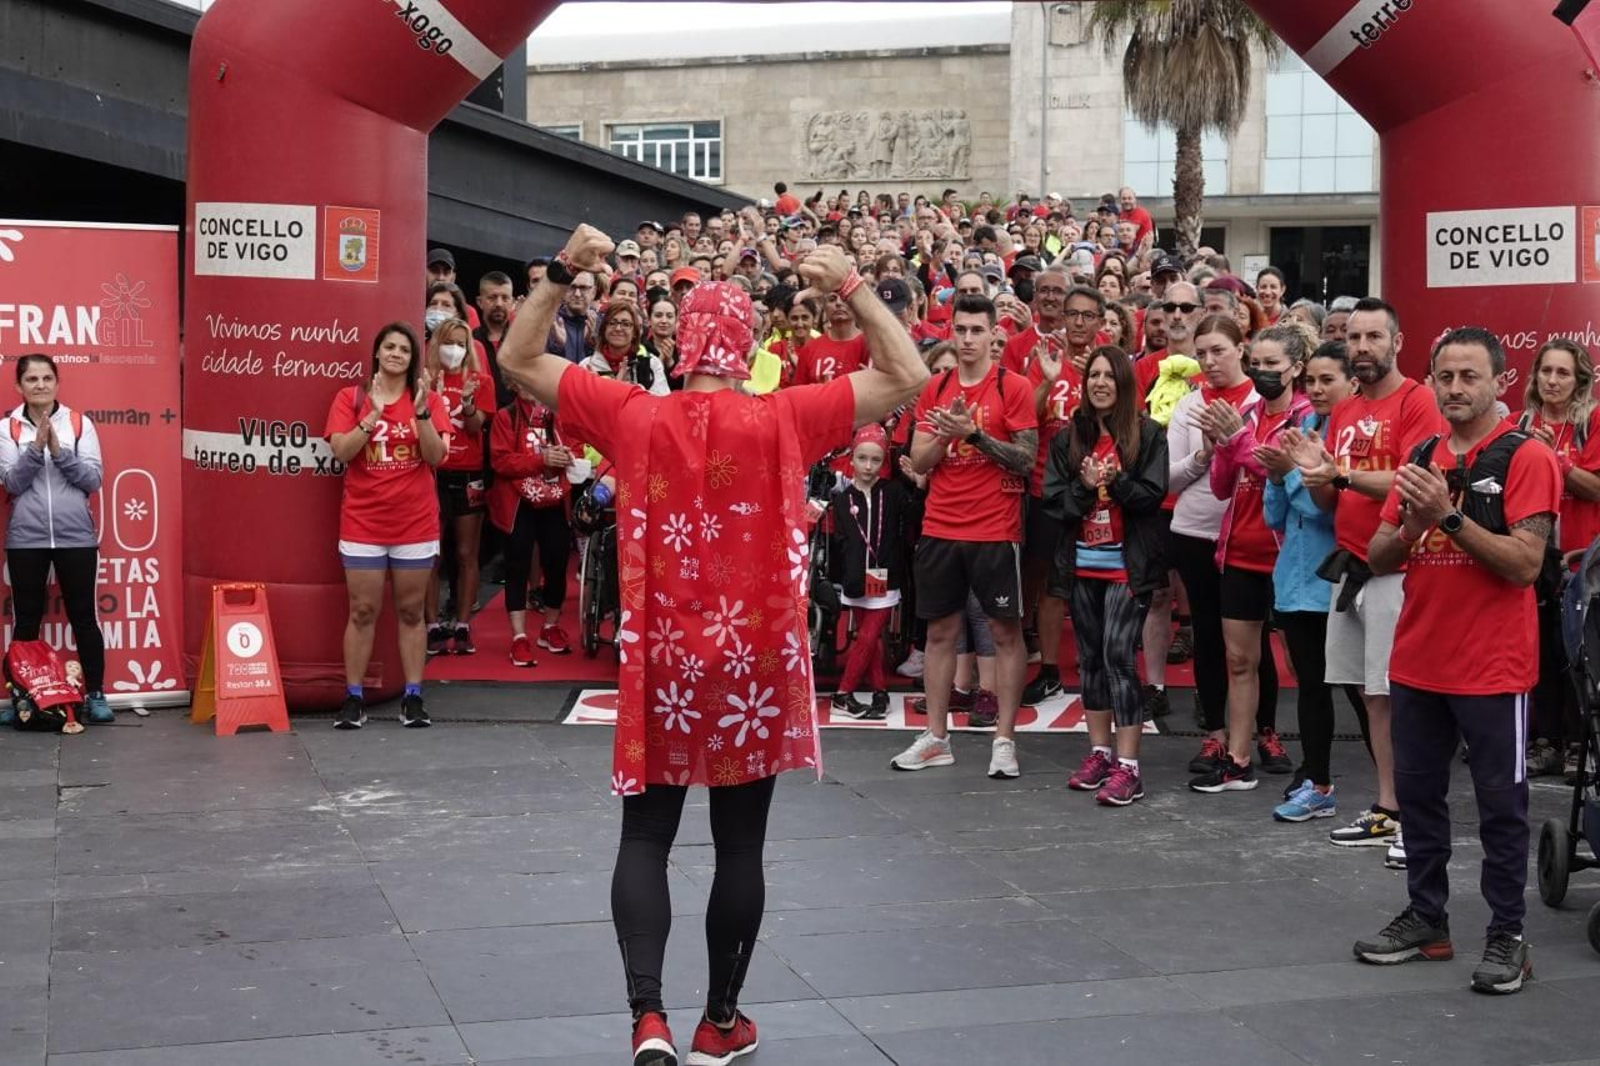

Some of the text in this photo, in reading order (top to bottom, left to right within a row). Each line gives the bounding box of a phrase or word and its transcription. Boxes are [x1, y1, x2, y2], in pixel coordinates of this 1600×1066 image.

[397, 1, 454, 55] xogo
[200, 217, 303, 239] CONCELLO
[1435, 222, 1565, 247] CONCELLO
[206, 241, 289, 261] DE VIGO
[1449, 247, 1550, 270] DE VIGO
[205, 313, 361, 345] Vivimos nunha
[201, 347, 364, 380] cidade fermosa
[239, 418, 318, 454] VIGO,
[194, 446, 256, 473] terreo
[269, 450, 301, 475] de
[314, 456, 347, 476] xo
[126, 586, 160, 618] LA
